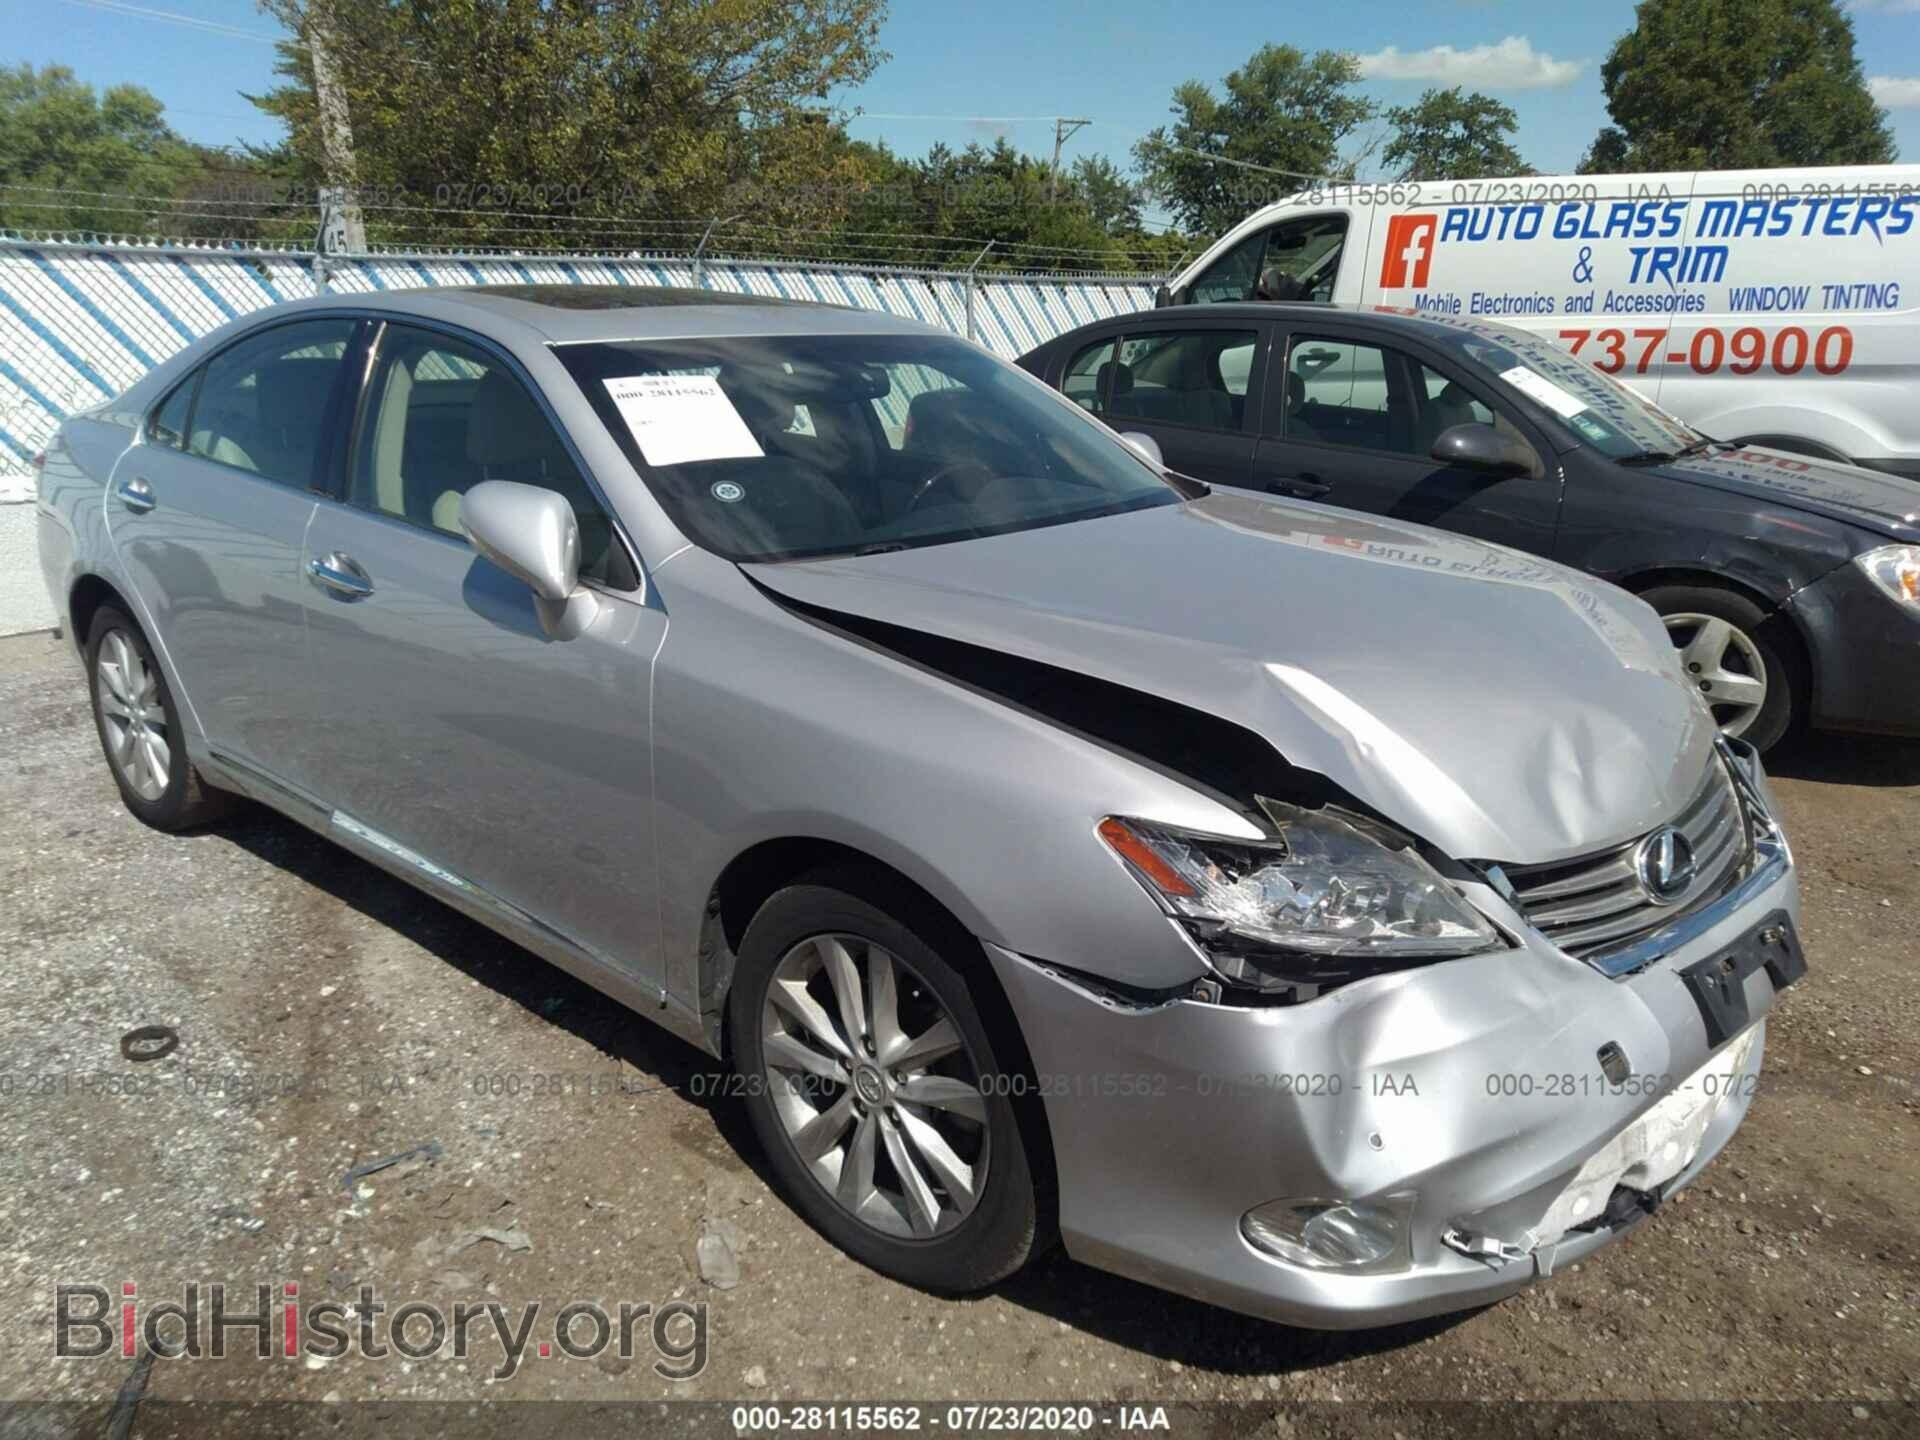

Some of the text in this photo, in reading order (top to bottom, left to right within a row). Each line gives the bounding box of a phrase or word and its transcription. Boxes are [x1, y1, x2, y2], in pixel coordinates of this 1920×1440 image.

[1440, 194, 1920, 248] AUTO GLASS MASTERS
[1572, 245, 1729, 294] & TRIM
[1415, 282, 1901, 315] Mobile Electronics and Accessories WINDOW TINTING
[1559, 325, 1854, 376] 737-0900
